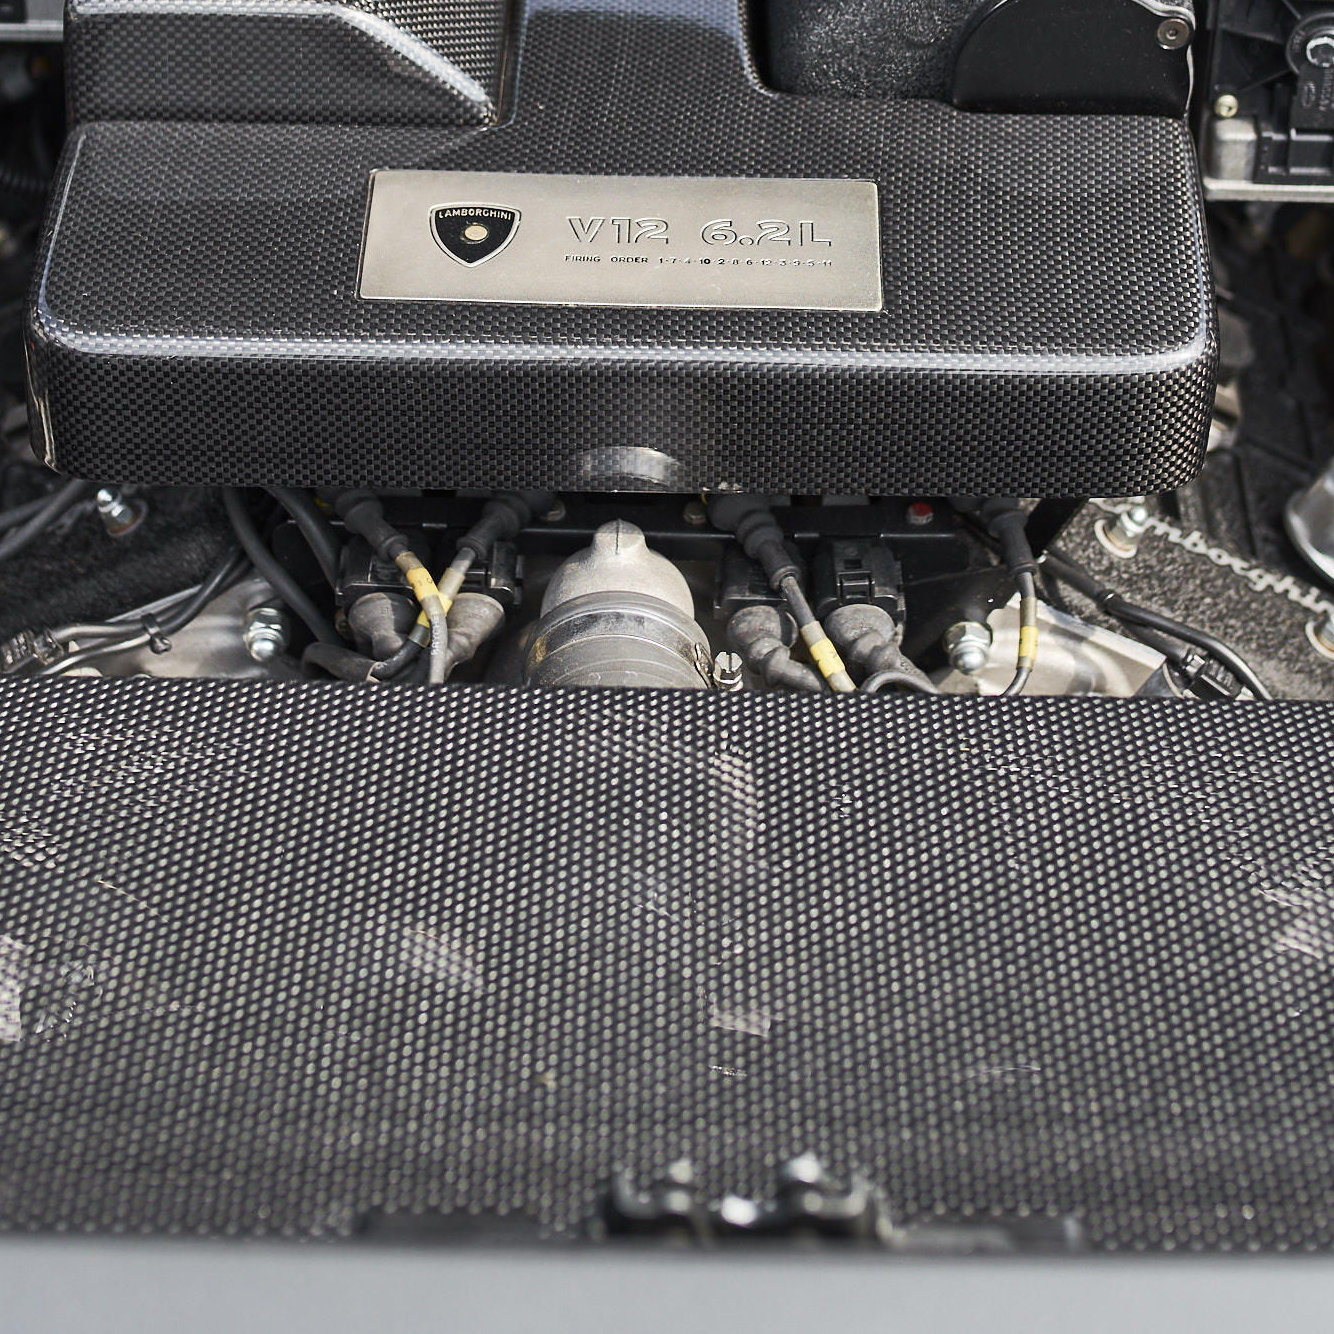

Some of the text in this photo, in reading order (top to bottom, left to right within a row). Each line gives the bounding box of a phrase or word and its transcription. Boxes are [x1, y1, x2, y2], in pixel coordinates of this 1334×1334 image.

[438, 208, 512, 221] LAMBORGHINI
[566, 217, 832, 247] V12 6.2L
[565, 255, 601, 263] FIRING
[610, 256, 649, 264] ORDER
